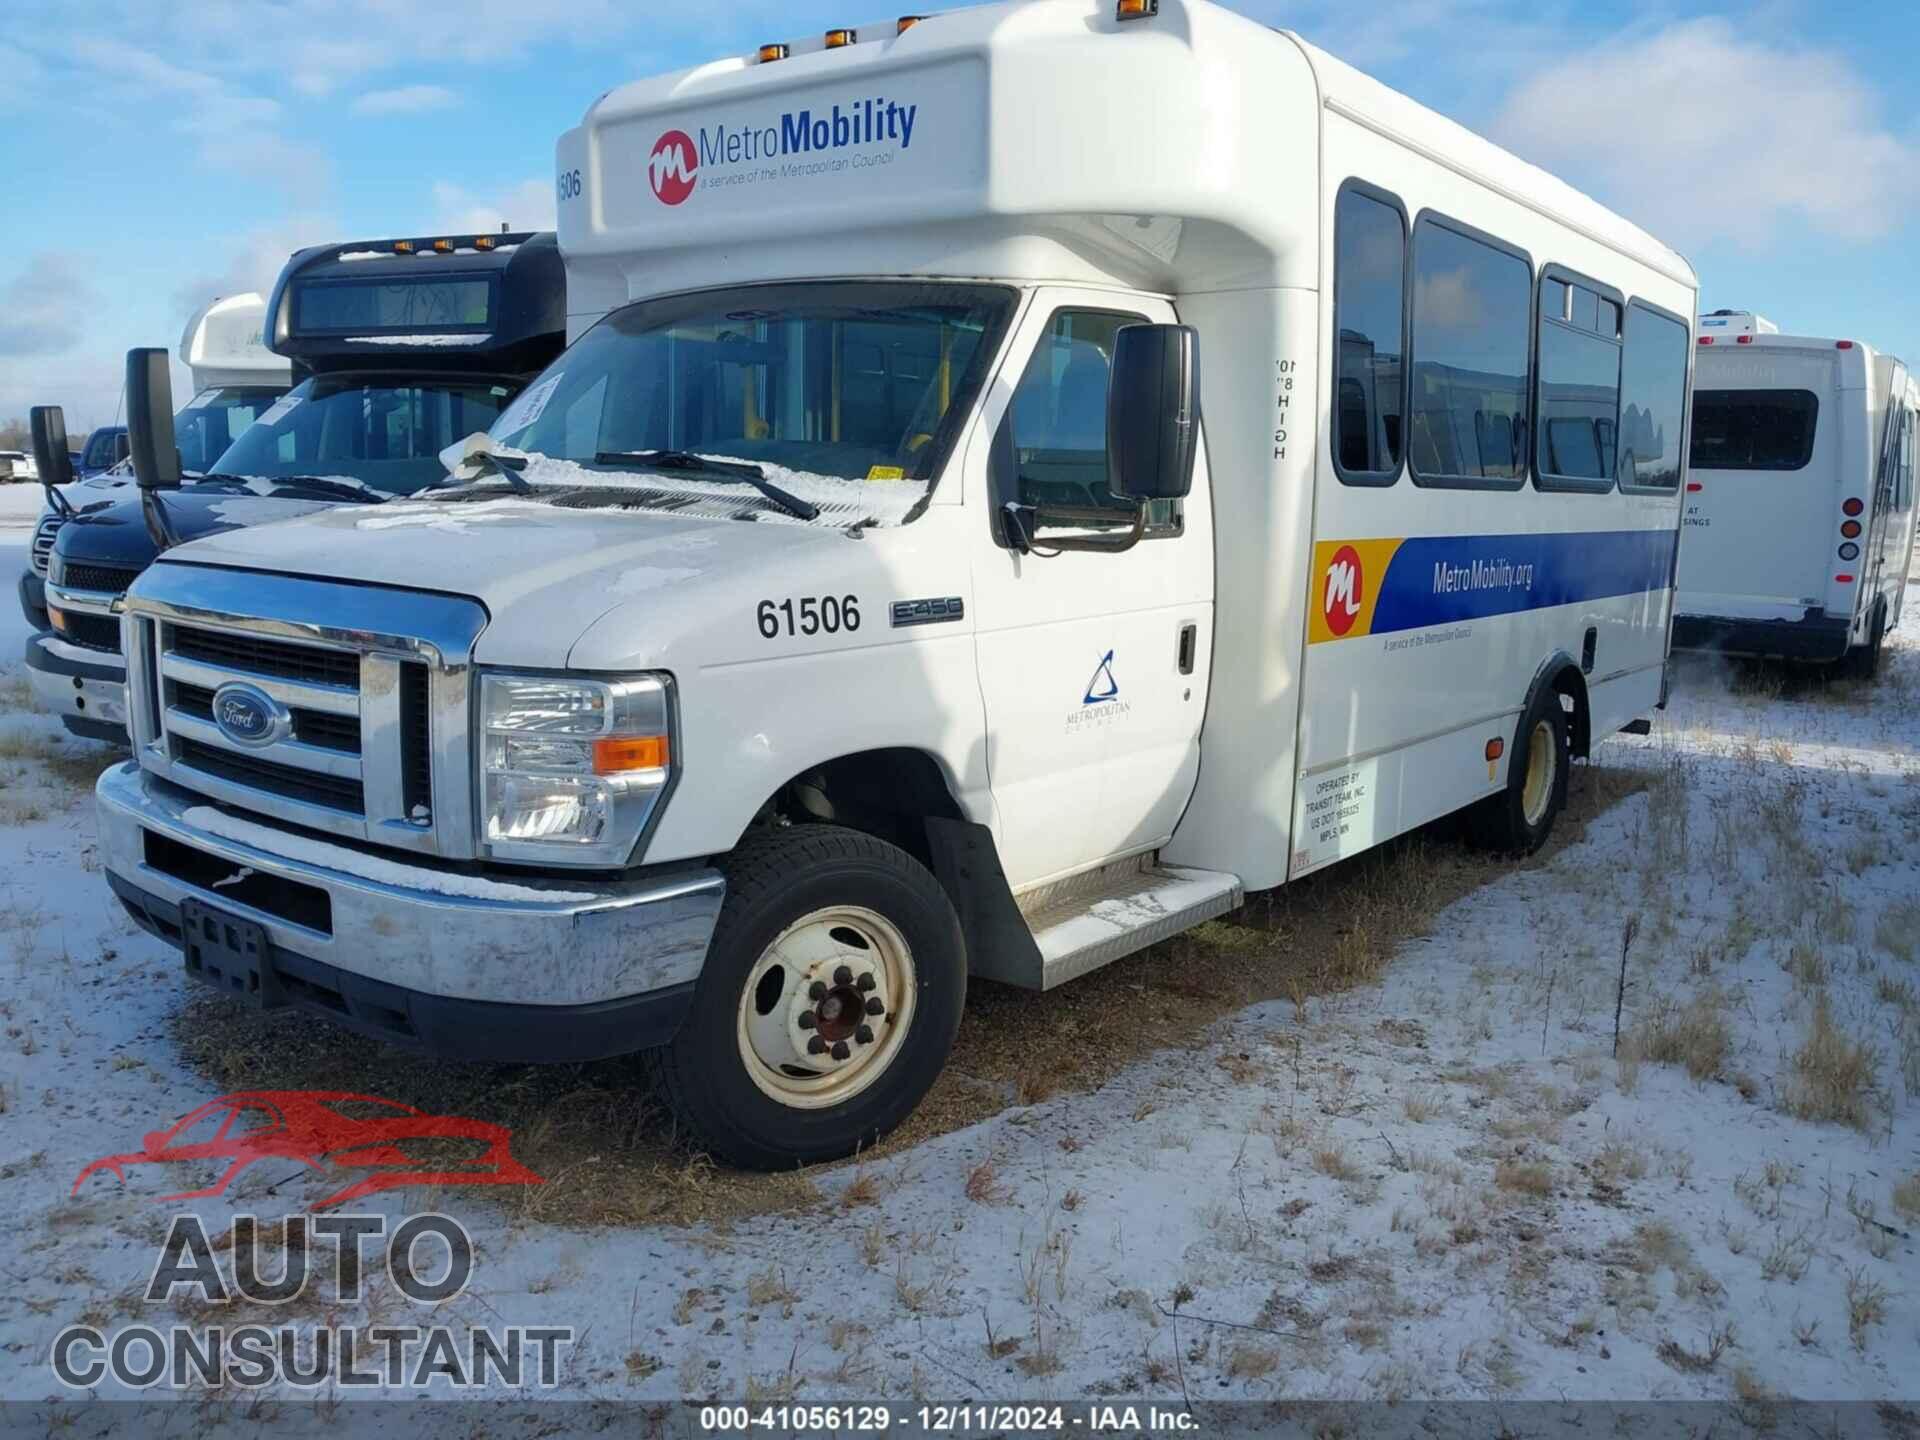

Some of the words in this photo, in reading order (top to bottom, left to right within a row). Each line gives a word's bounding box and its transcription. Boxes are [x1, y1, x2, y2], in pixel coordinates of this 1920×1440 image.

[700, 98, 917, 167] MetroMobility
[709, 171, 745, 188] service
[748, 168, 760, 184] of
[760, 166, 777, 181] the
[780, 157, 849, 178] Metropolitan
[852, 151, 895, 169] Council
[1683, 517, 1711, 527] SINGS
[1688, 506, 1698, 514] AT
[1433, 557, 1534, 594] MetroMobility.org
[756, 594, 861, 639] 61506
[223, 700, 254, 729] Ford
